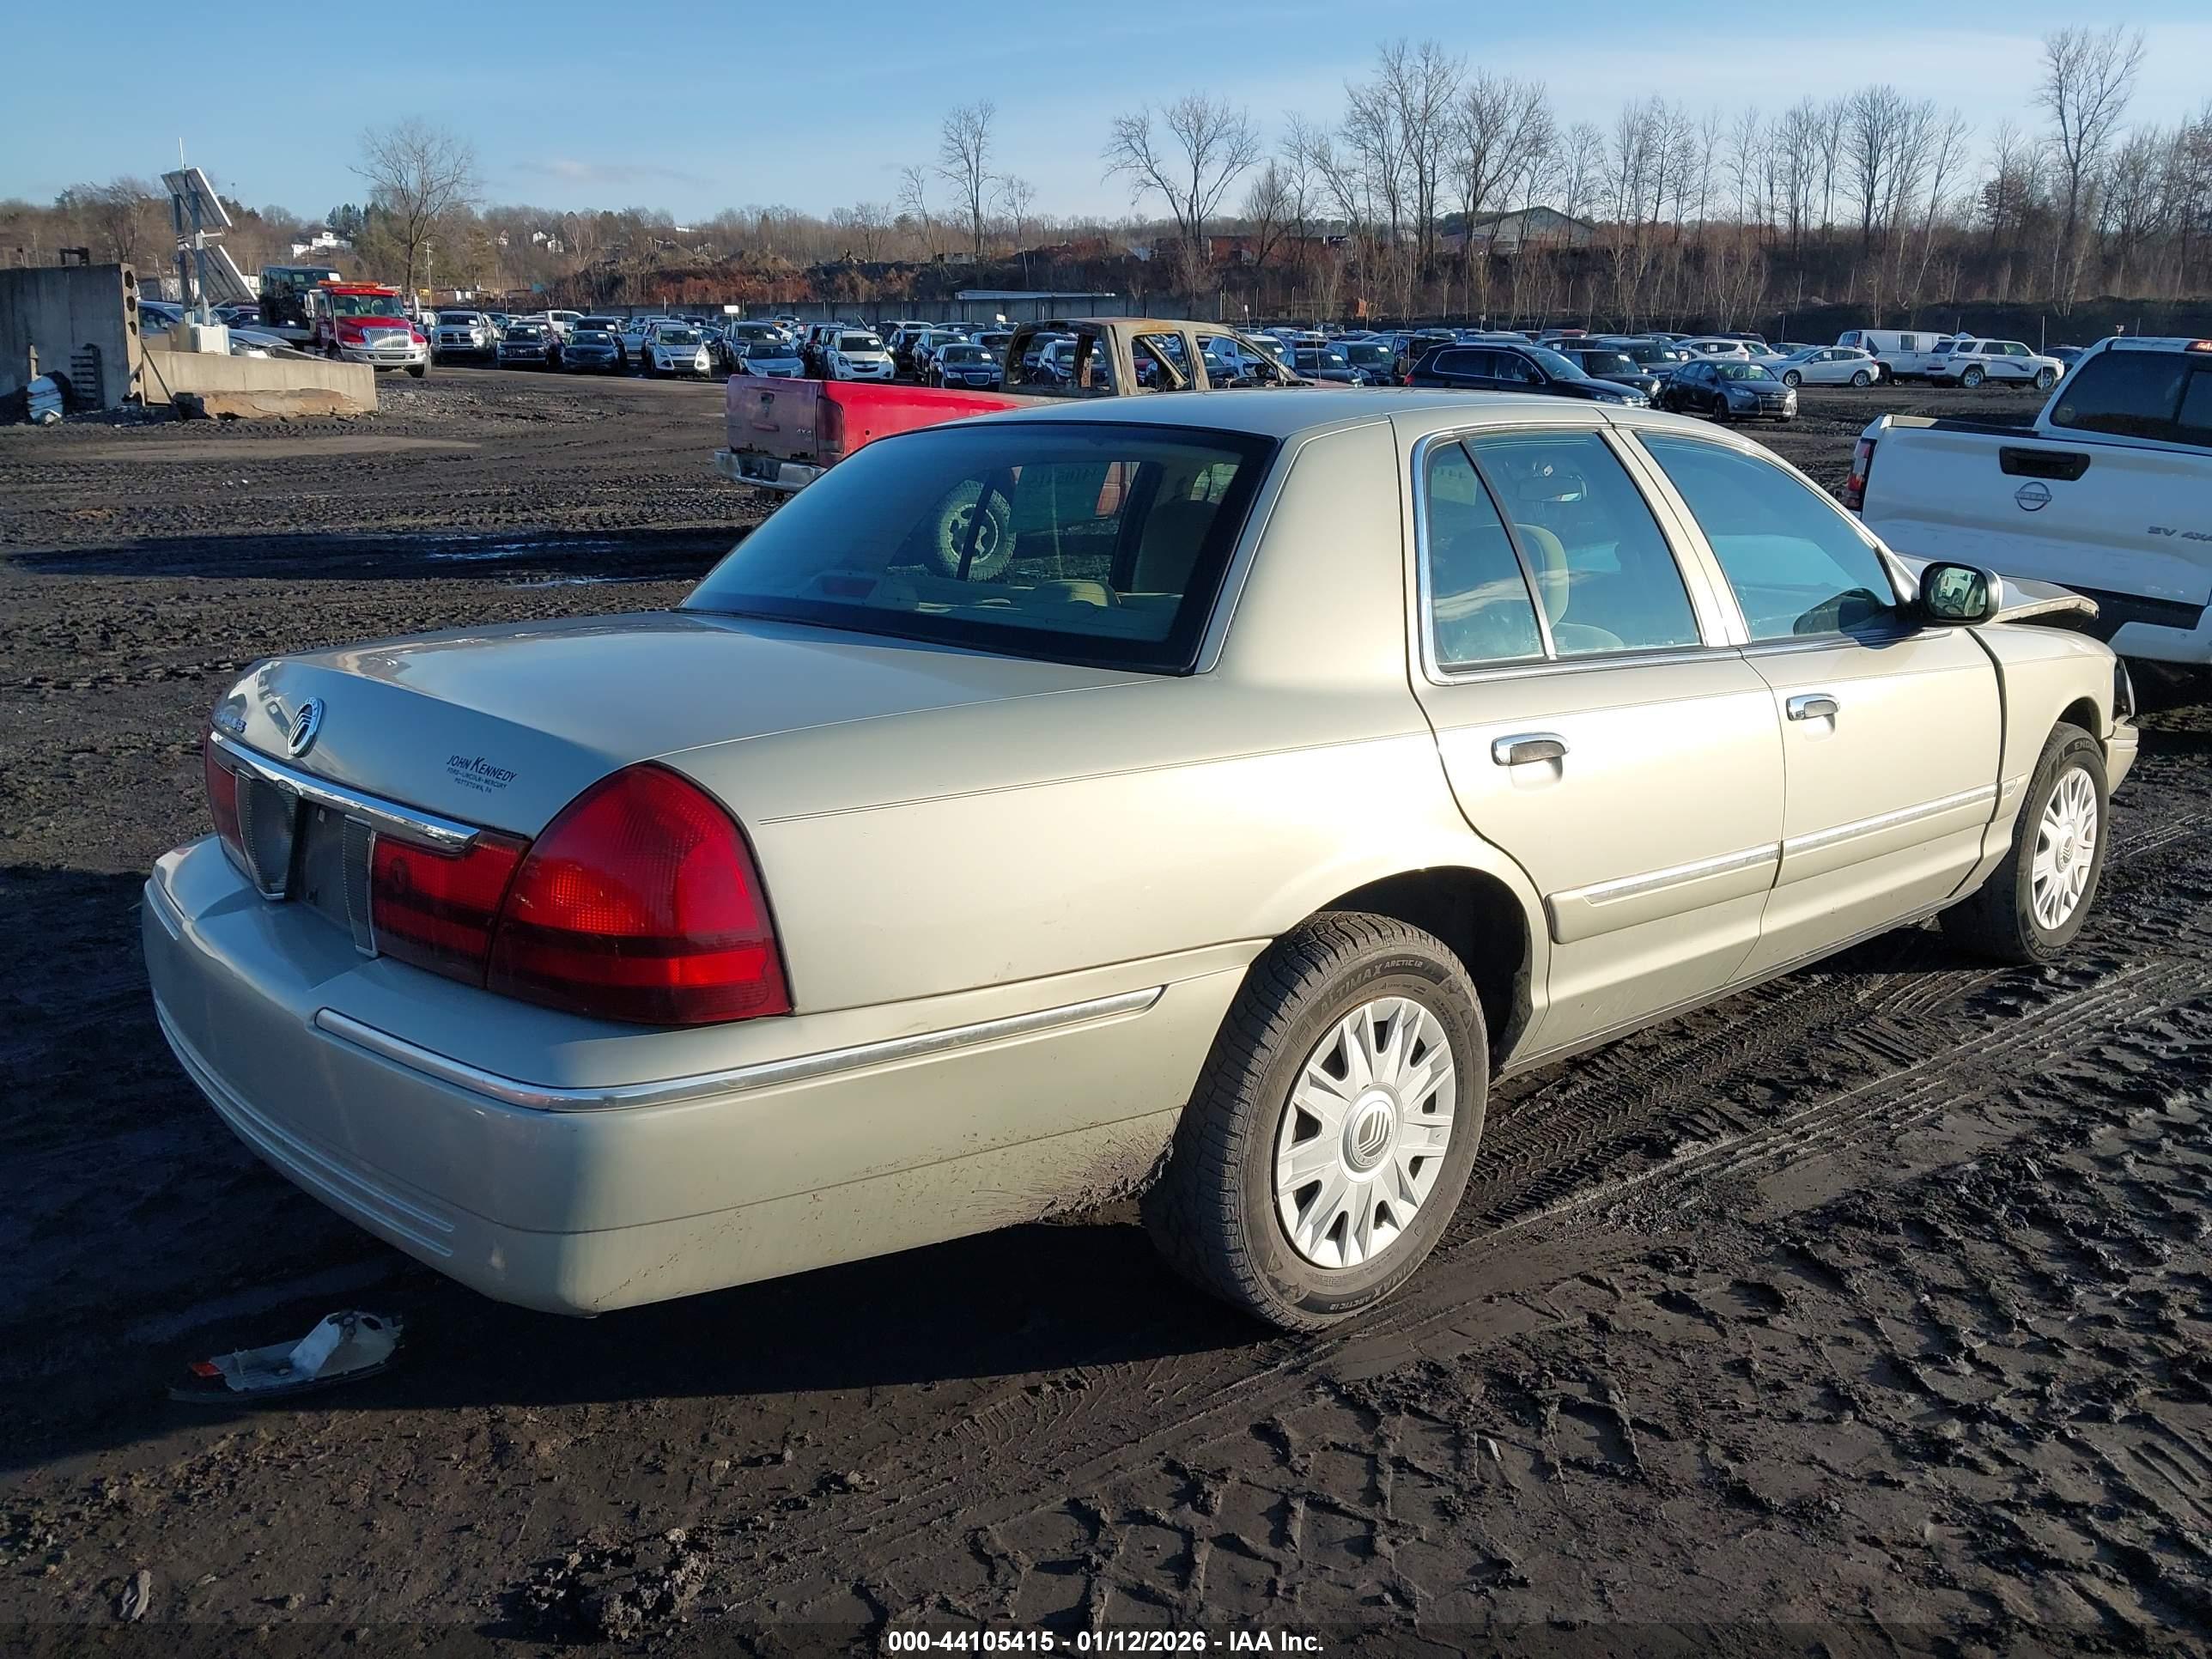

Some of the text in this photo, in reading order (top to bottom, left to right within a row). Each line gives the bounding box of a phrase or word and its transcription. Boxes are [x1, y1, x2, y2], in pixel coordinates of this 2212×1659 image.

[447, 755, 518, 782] JOHN KENNEDY
[1320, 963, 1383, 1016] ALTIMAX
[1384, 959, 1414, 969] ARCTIC
